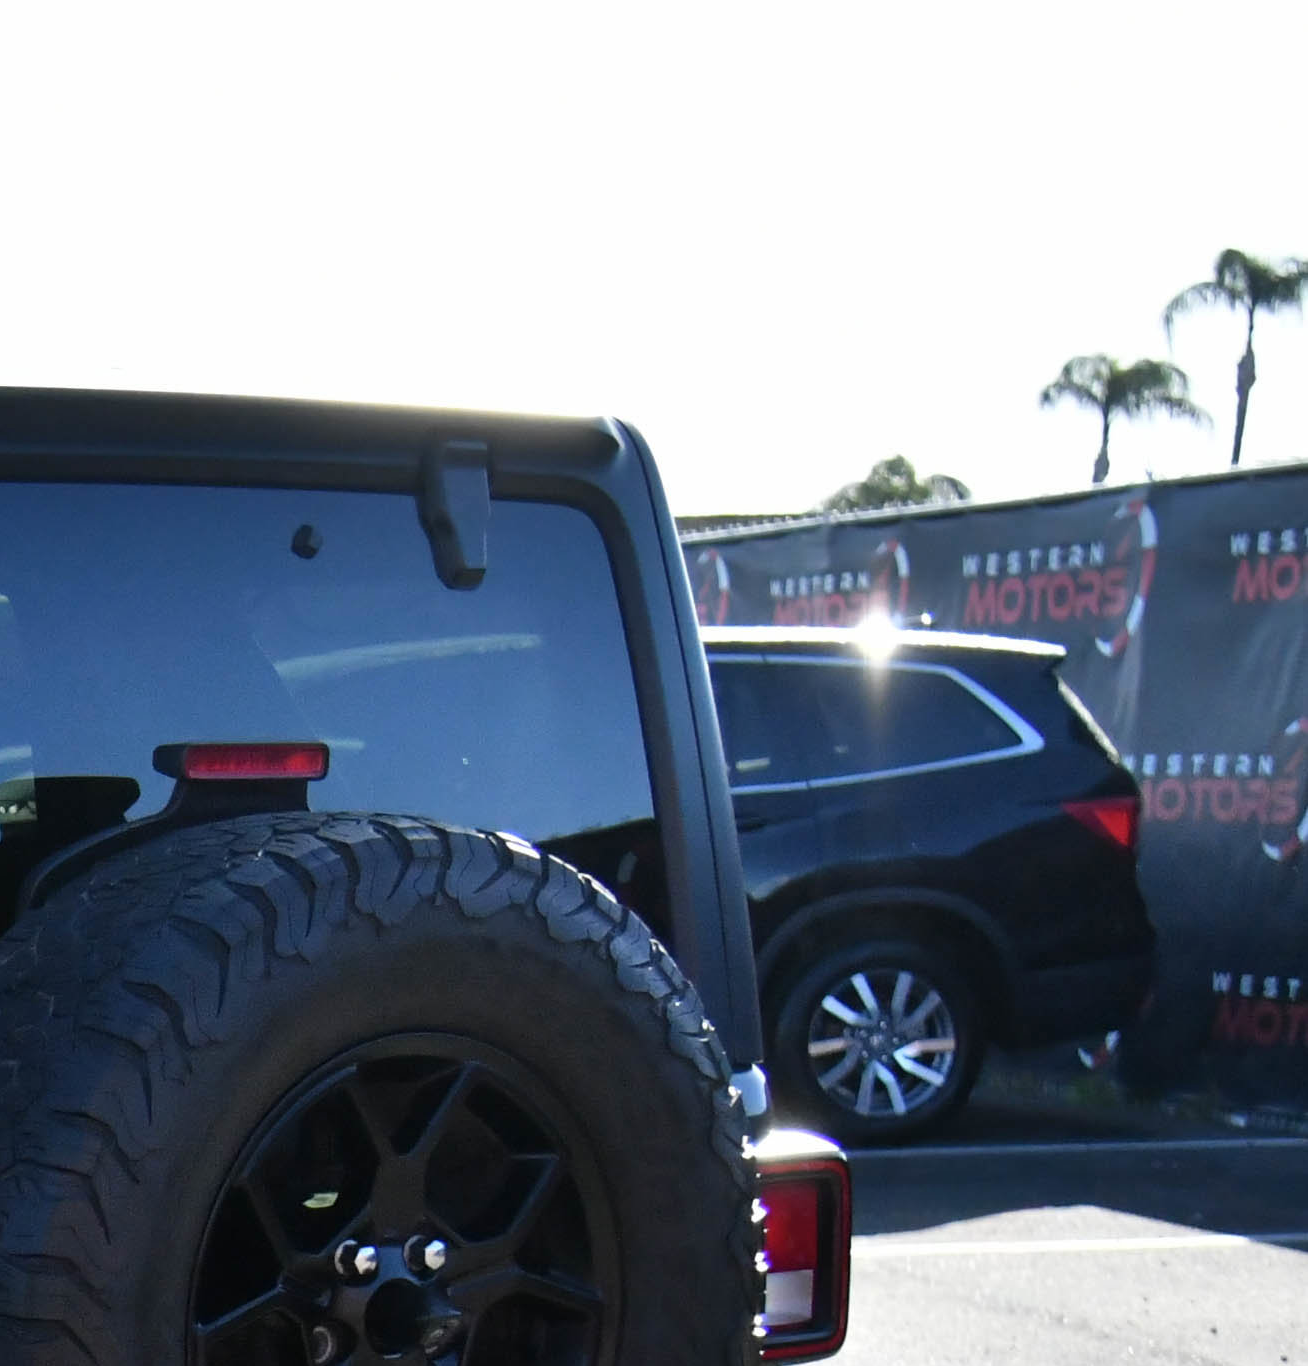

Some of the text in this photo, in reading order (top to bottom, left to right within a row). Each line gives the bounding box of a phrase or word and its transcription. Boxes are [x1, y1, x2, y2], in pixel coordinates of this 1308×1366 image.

[962, 540, 1106, 578] WESTERN
[962, 566, 1129, 627] MOTORS
[1140, 776, 1299, 825] OTORS
